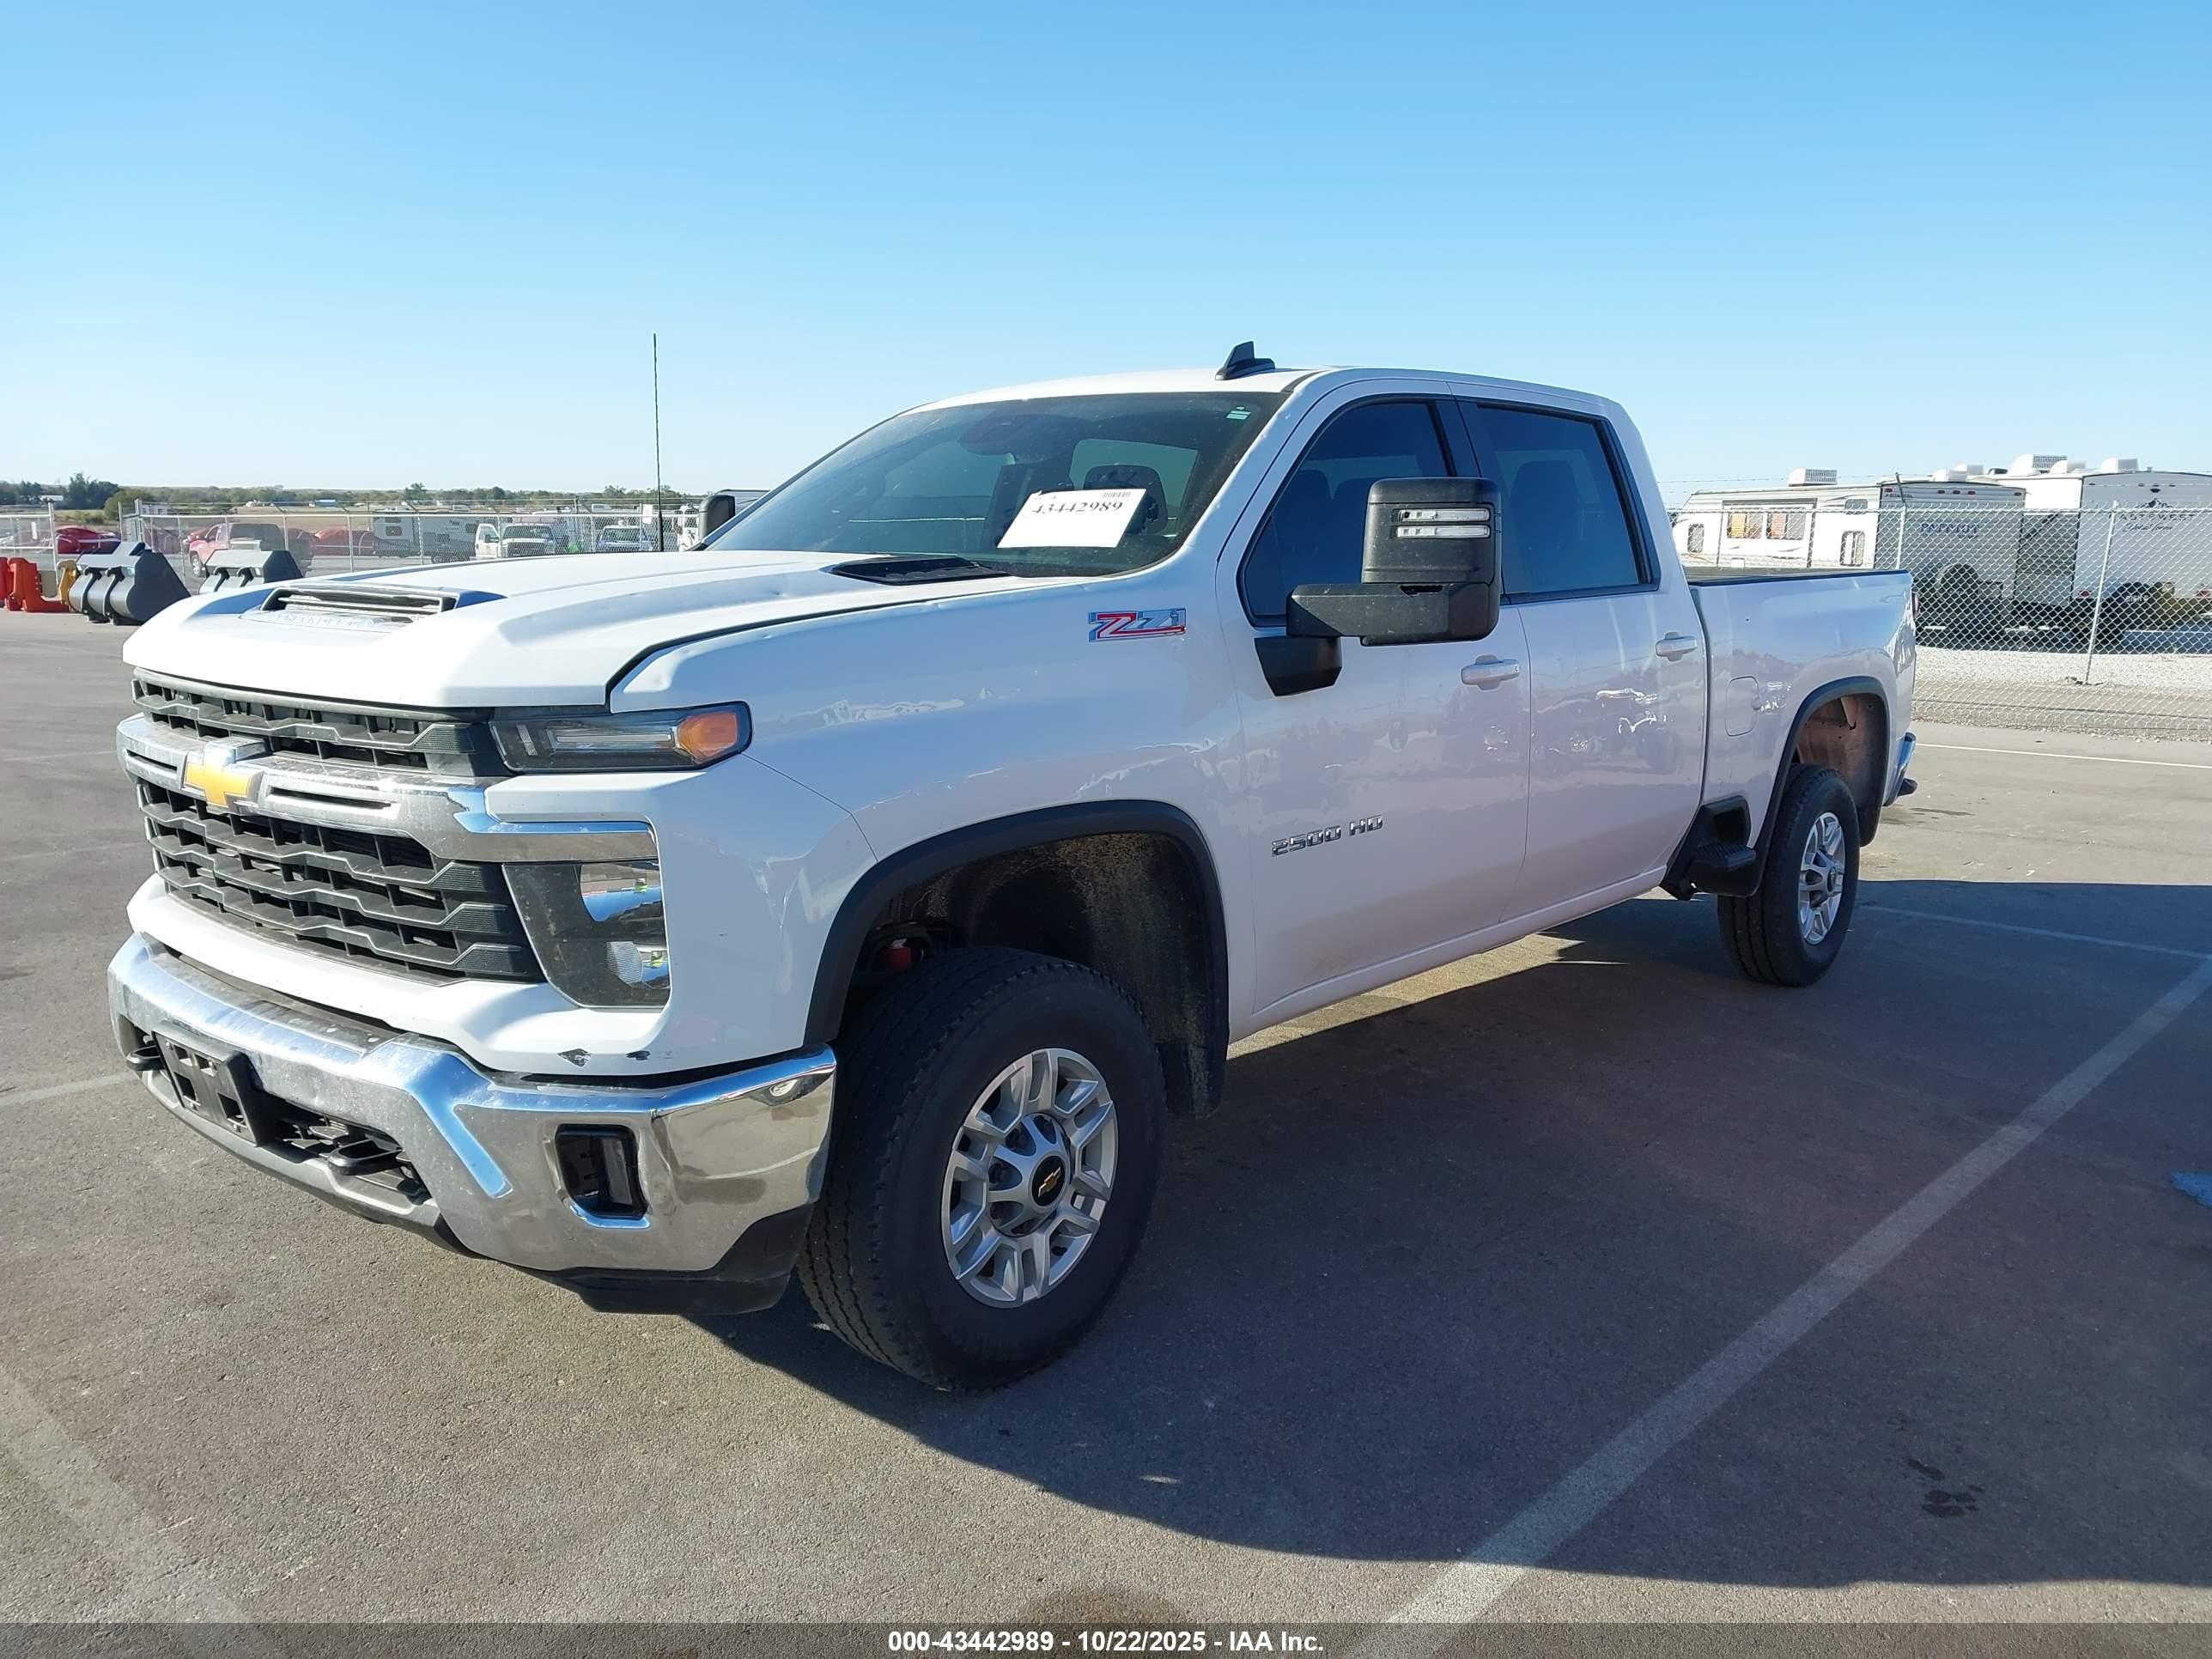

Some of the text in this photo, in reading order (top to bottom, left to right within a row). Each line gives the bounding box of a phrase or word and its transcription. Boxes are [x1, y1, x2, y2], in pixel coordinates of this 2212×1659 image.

[1032, 501, 1123, 514] 43442989
[1088, 608, 1187, 642] Z71
[1271, 815, 1383, 857] 2500 HD
